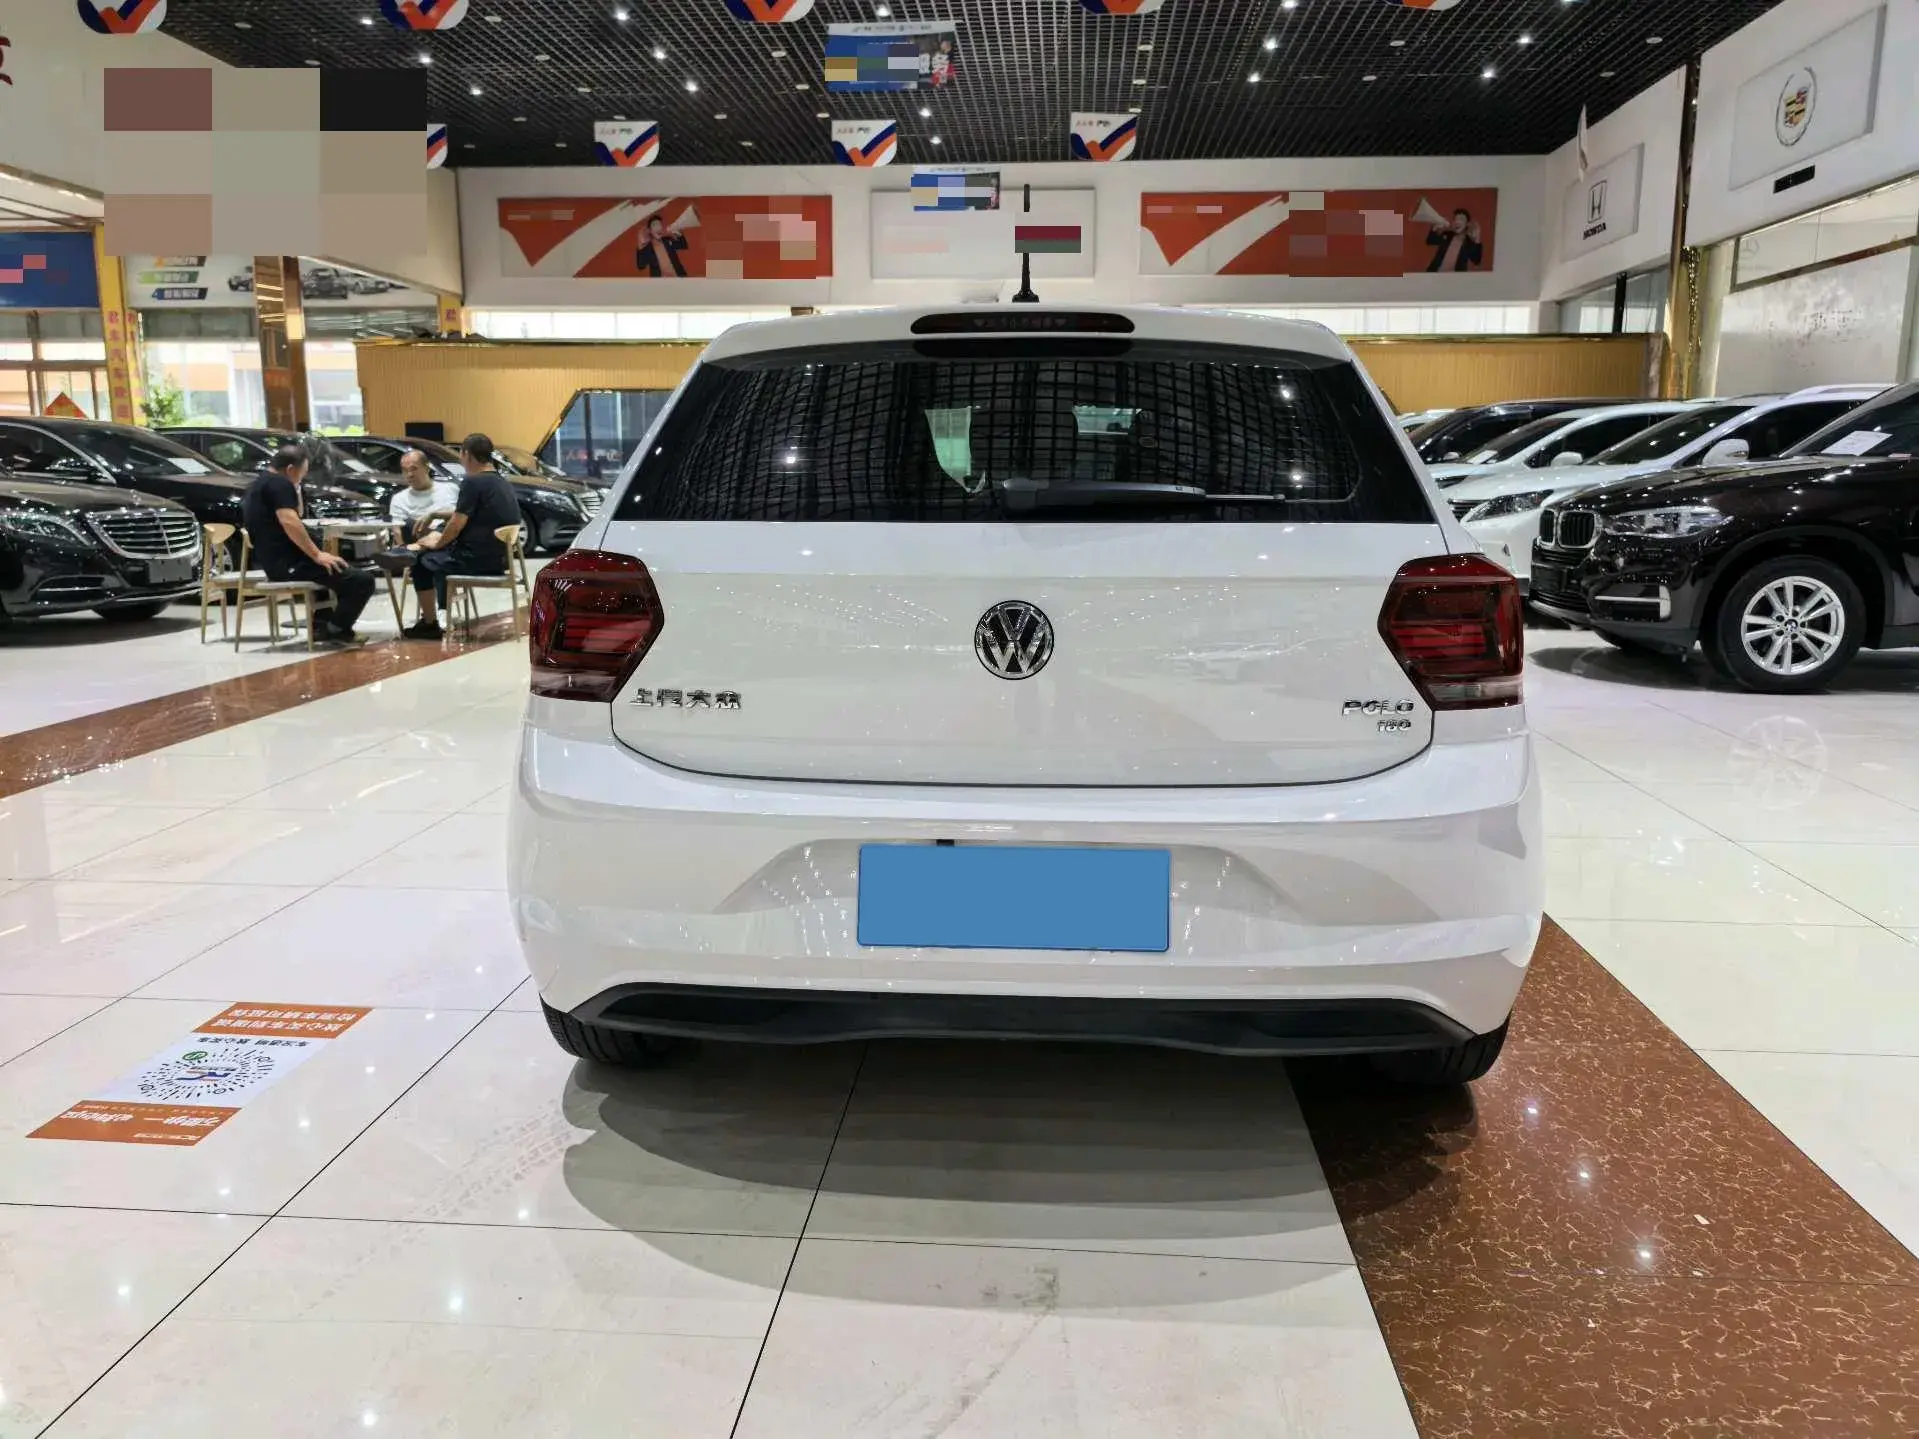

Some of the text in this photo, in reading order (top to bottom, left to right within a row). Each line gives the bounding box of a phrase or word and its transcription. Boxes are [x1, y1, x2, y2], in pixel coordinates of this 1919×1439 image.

[629, 688, 742, 710] 上汽大众
[1342, 699, 1415, 716] POLO
